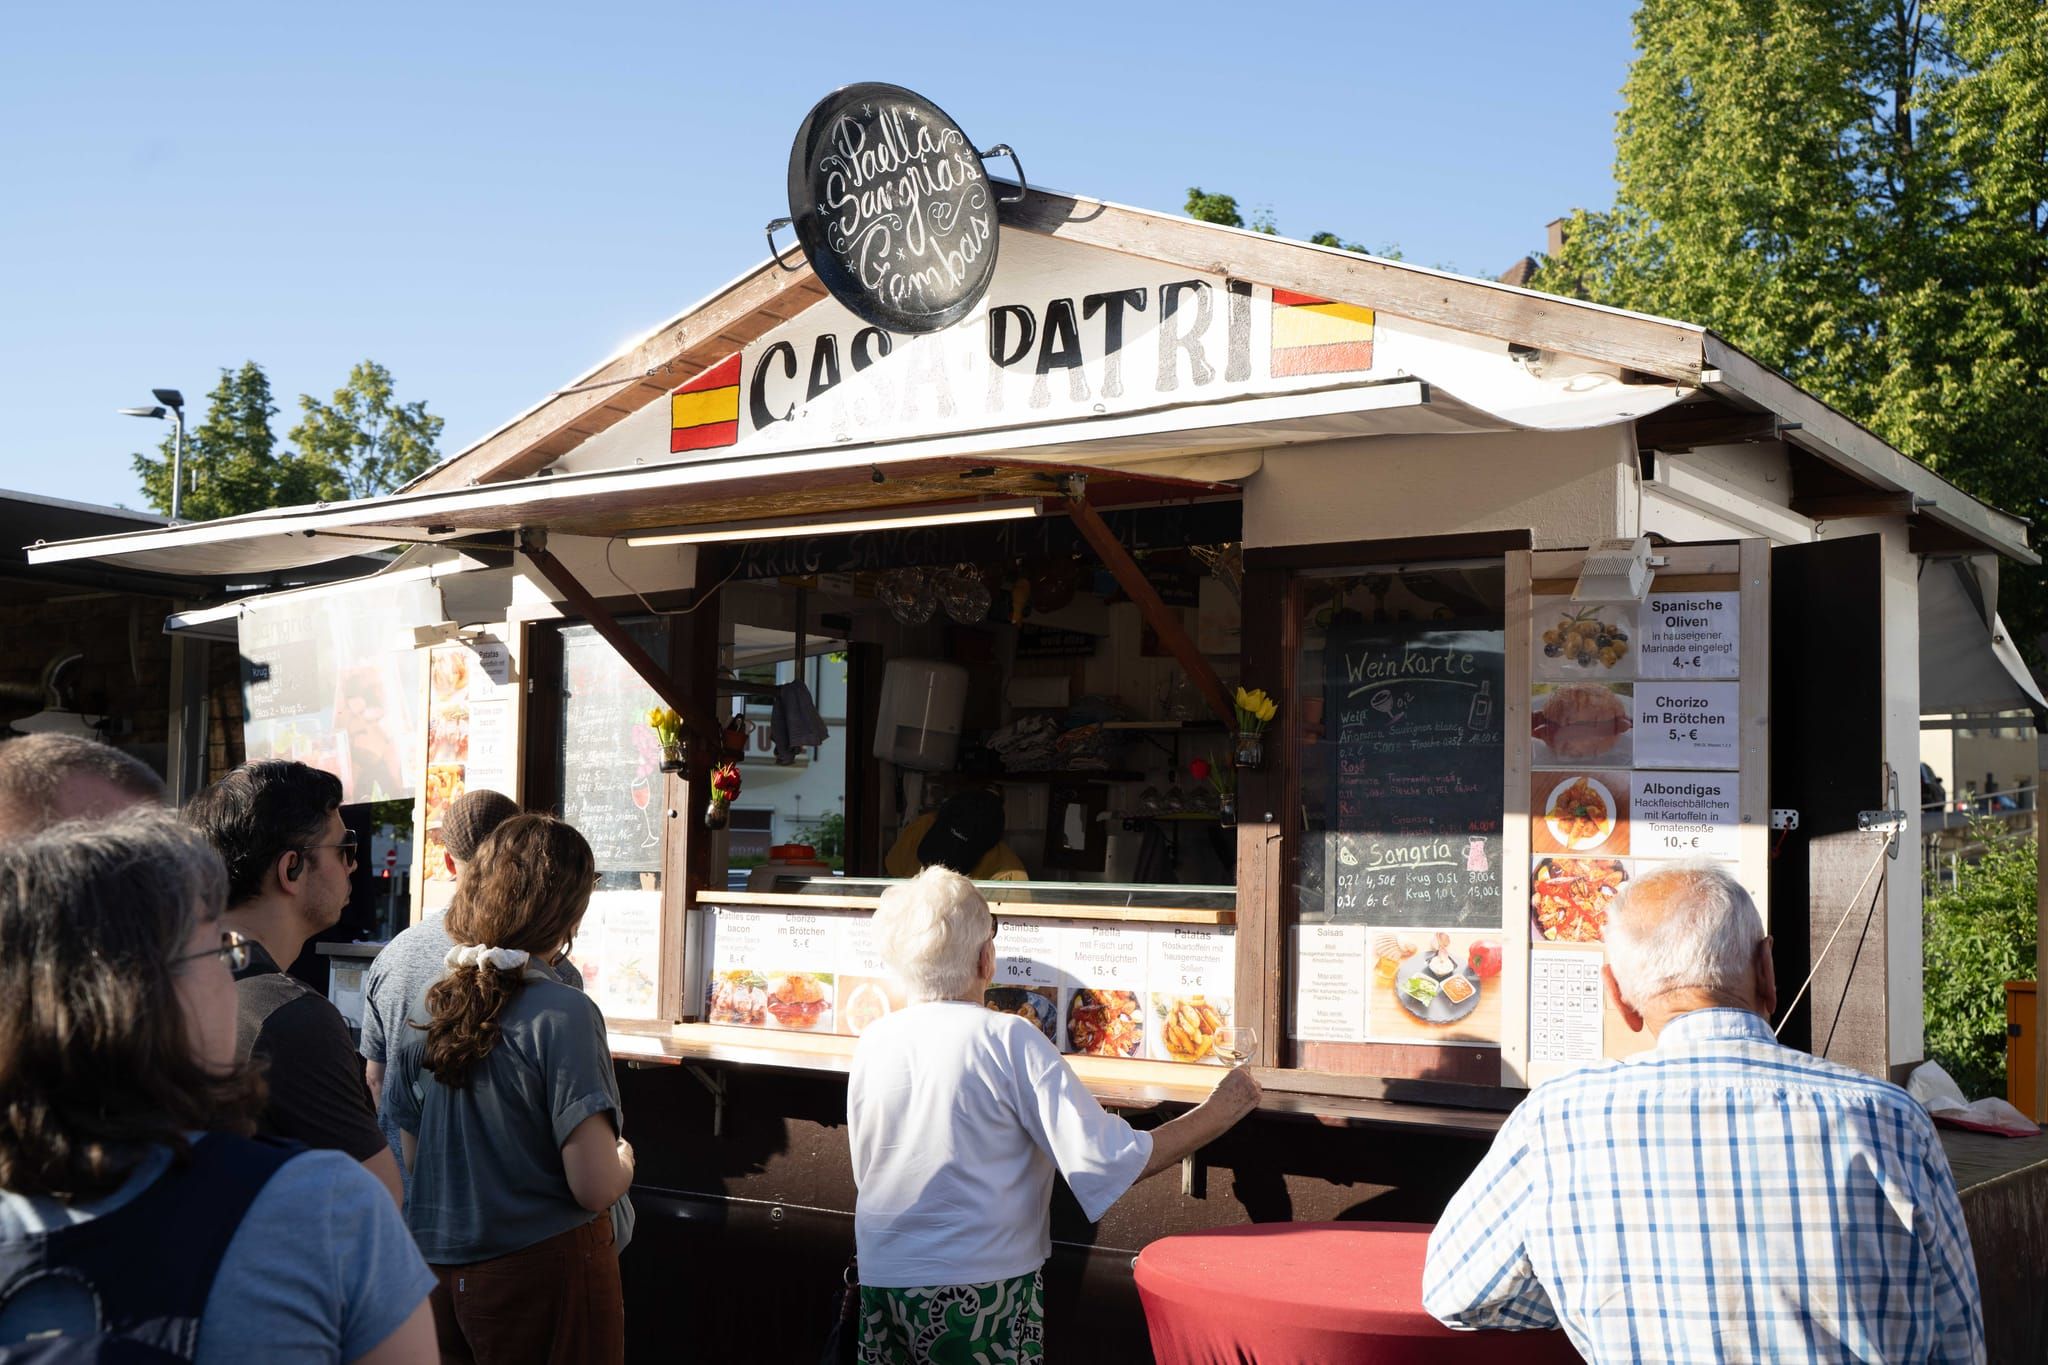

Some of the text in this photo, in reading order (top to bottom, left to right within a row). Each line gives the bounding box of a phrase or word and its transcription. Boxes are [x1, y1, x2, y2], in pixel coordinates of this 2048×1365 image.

[832, 106, 962, 187] Paella
[826, 155, 981, 257] Sangrias
[860, 213, 991, 304] Gambas
[986, 278, 1252, 412] PATRI
[1652, 600, 1723, 614] Spanische
[1665, 616, 1708, 628] Oliven
[1652, 631, 1722, 643] in hauseigener
[1641, 643, 1733, 655] Marinade eingelegt
[1345, 640, 1475, 683] Weinkarte
[1692, 657, 1701, 667] €
[1655, 696, 1709, 708] Chorizo
[1642, 712, 1725, 724] im Brötchen
[1689, 729, 1698, 740] €
[1643, 783, 1721, 798] Albondigas
[1634, 798, 1730, 809] Hackfleischbällchen
[1644, 811, 1719, 821] mit Kartoffeln in
[1649, 822, 1714, 834] Tomatensoße
[1690, 837, 1700, 848] €
[1368, 838, 1452, 870] Sangría
[1405, 872, 1431, 885] Krug
[1406, 889, 1431, 901] Krug
[785, 912, 816, 923] Chorizo
[727, 924, 750, 934] bacon
[1002, 921, 1040, 932] Gambas
[1092, 926, 1121, 937] Paella
[1317, 927, 1344, 937] Salsas
[1174, 928, 1212, 940] Patatas
[1079, 941, 1134, 951] mit Fisch und
[1212, 944, 1224, 952] mit
[1025, 966, 1032, 976] €
